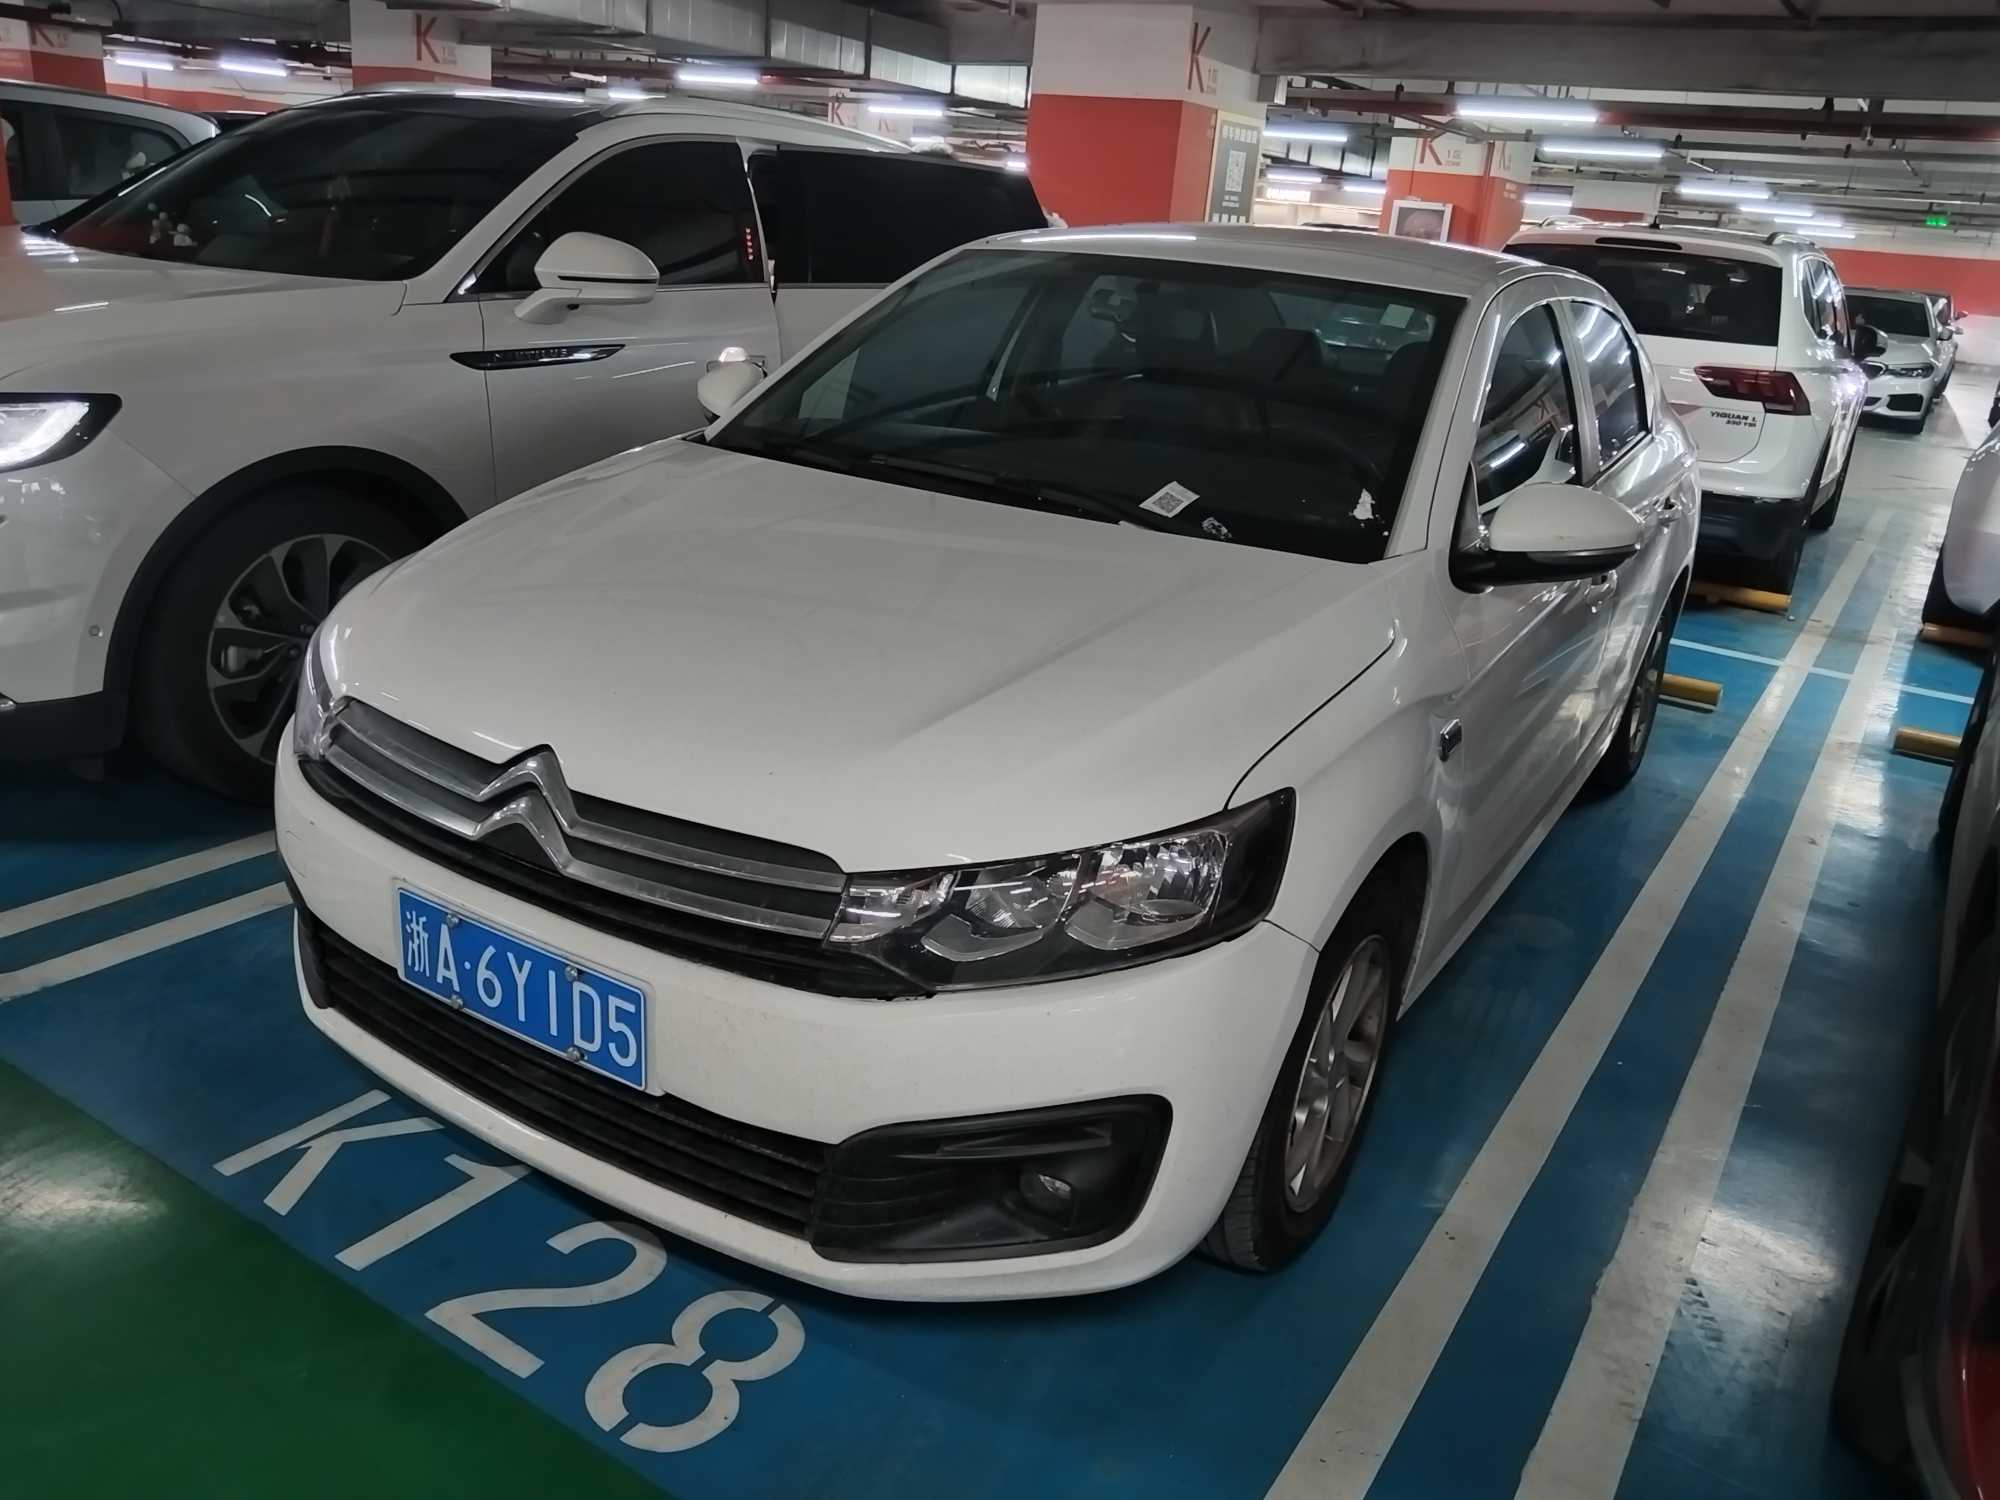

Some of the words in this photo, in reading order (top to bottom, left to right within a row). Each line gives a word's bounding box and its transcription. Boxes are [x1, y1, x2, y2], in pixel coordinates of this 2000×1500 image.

[416, 14, 440, 63] K
[1188, 22, 1211, 93] K
[213, 1089, 806, 1453] K128
